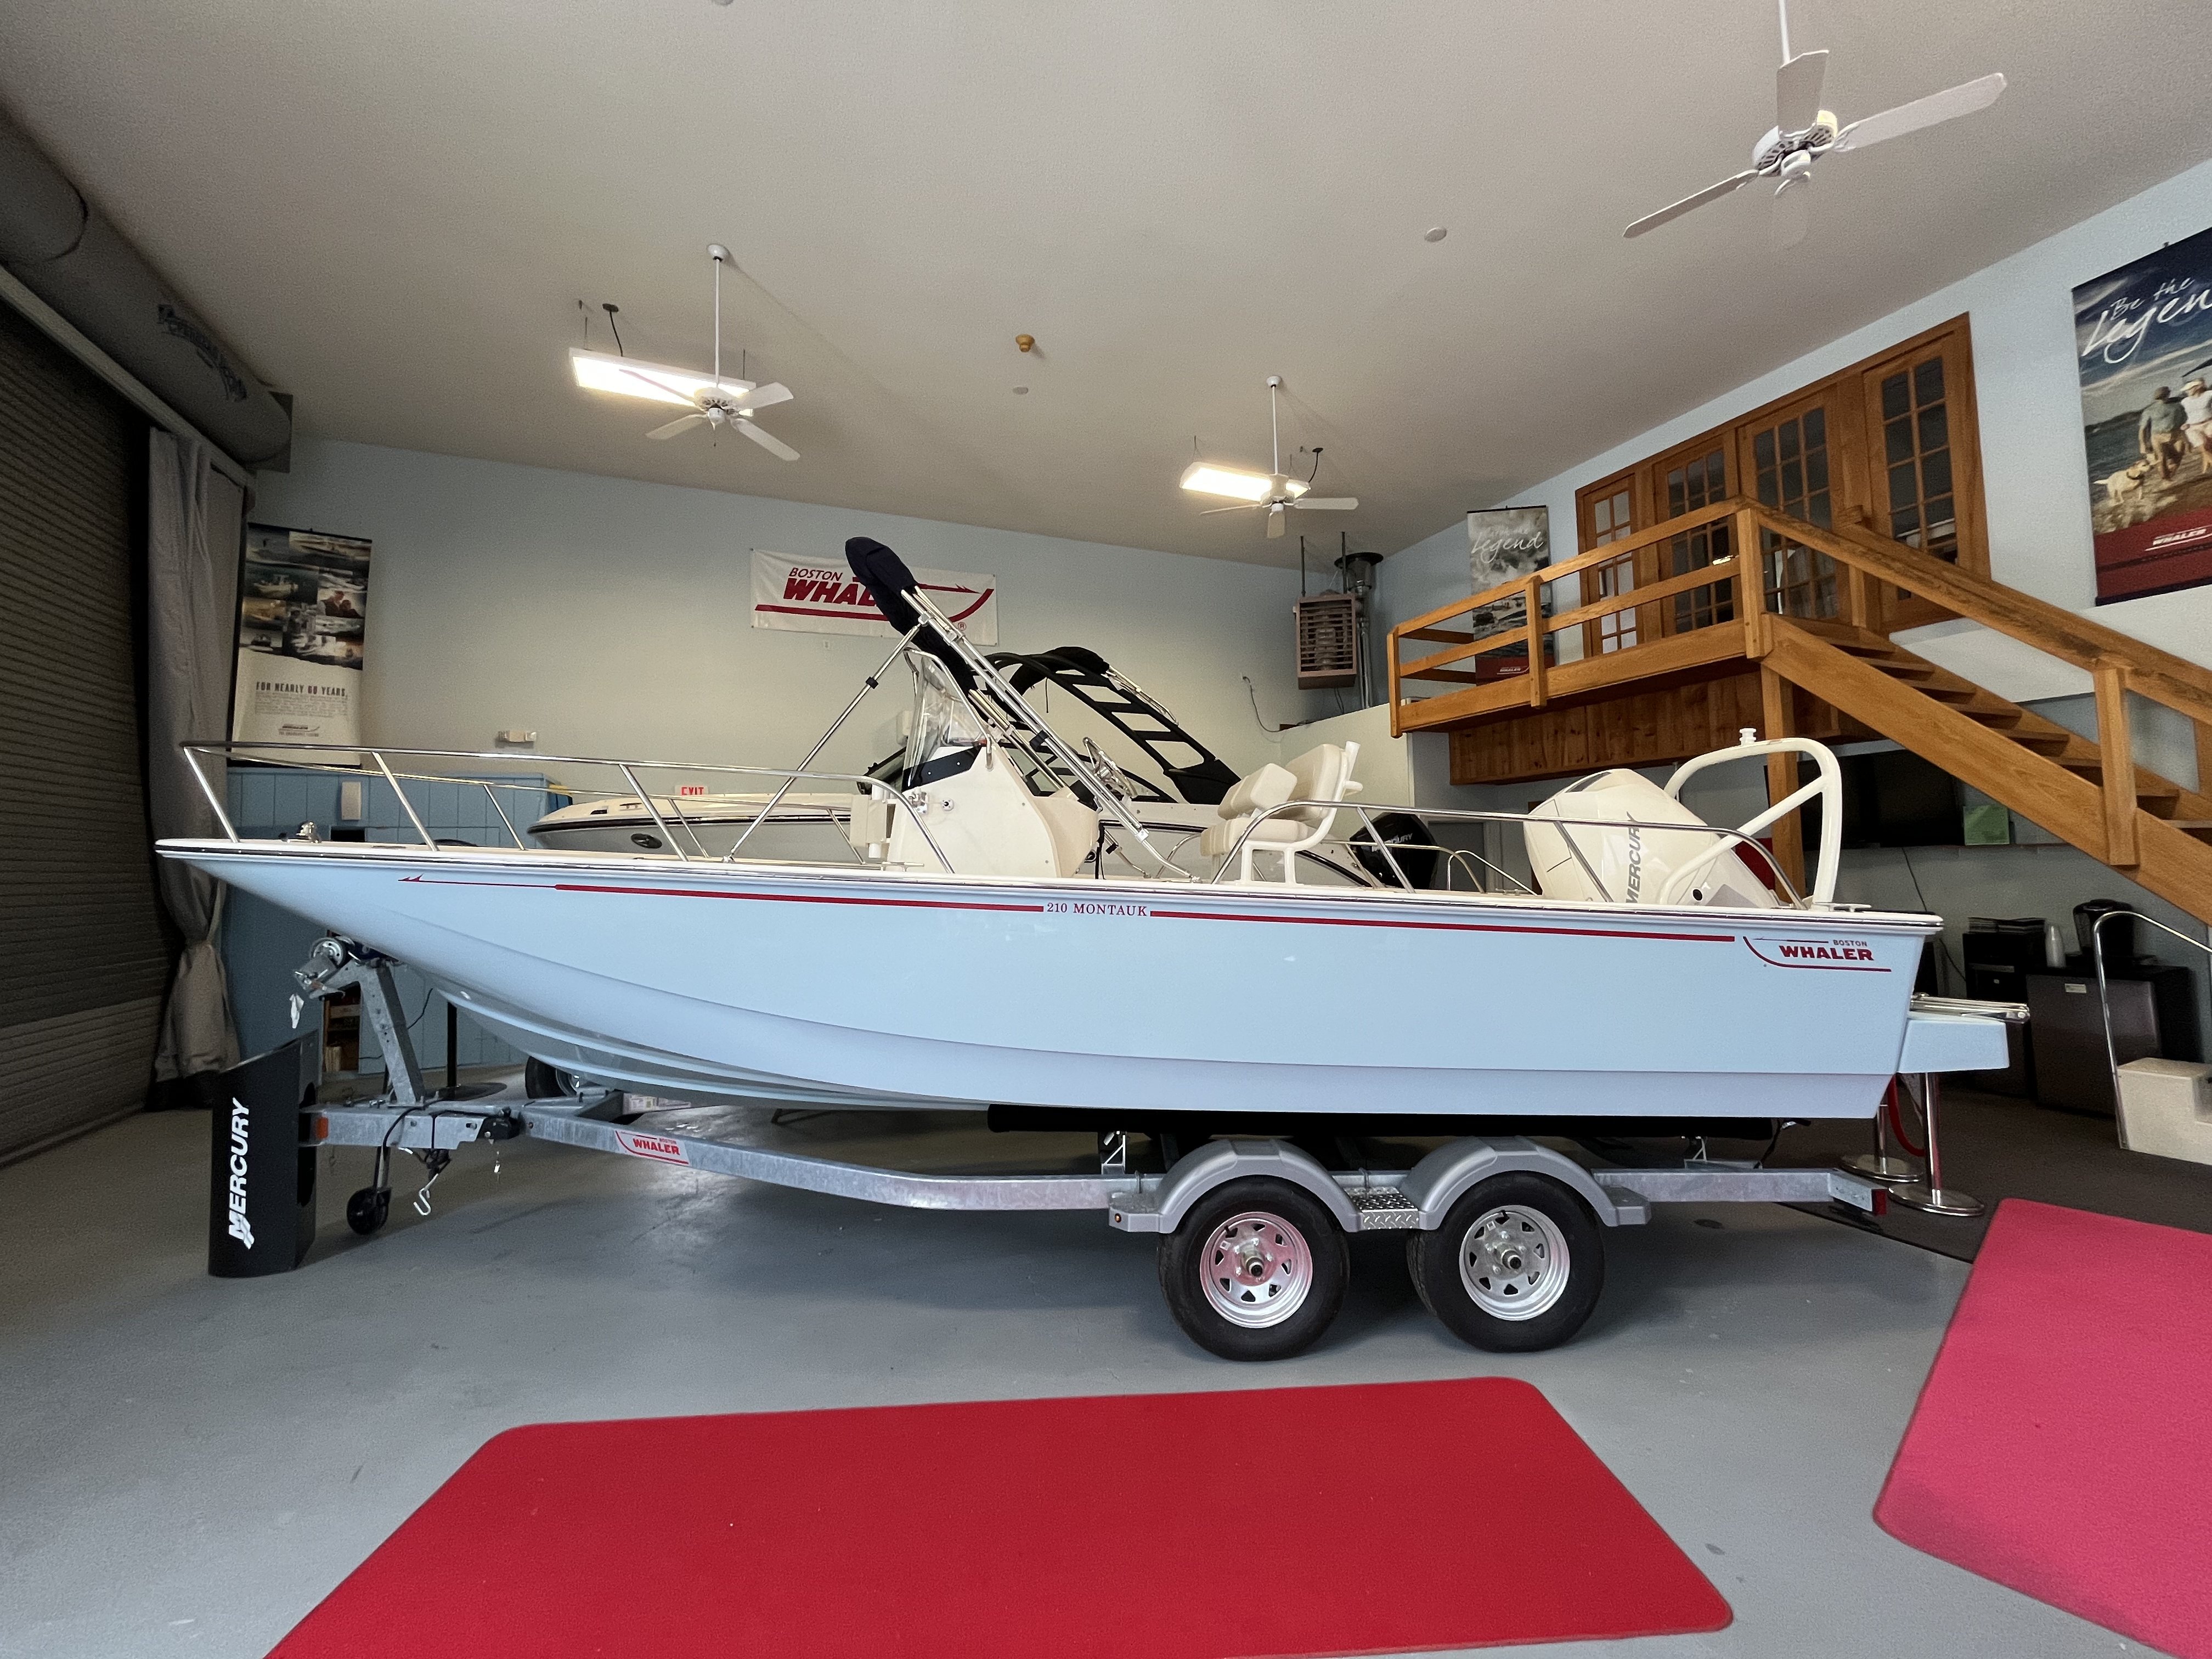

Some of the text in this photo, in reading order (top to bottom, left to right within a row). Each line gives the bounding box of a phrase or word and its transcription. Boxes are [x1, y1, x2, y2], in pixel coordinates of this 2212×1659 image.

[2110, 278, 2195, 320] Be the
[789, 567, 843, 581] BOSTON
[783, 578, 876, 606] WHAL
[256, 681, 270, 691] FOR
[275, 683, 304, 693] NEARLY
[1047, 902, 1148, 917] 210 MONTAUK
[1779, 945, 1874, 961] WHALER
[633, 1138, 680, 1155] WHALER
[228, 1097, 255, 1249] MERCURY
